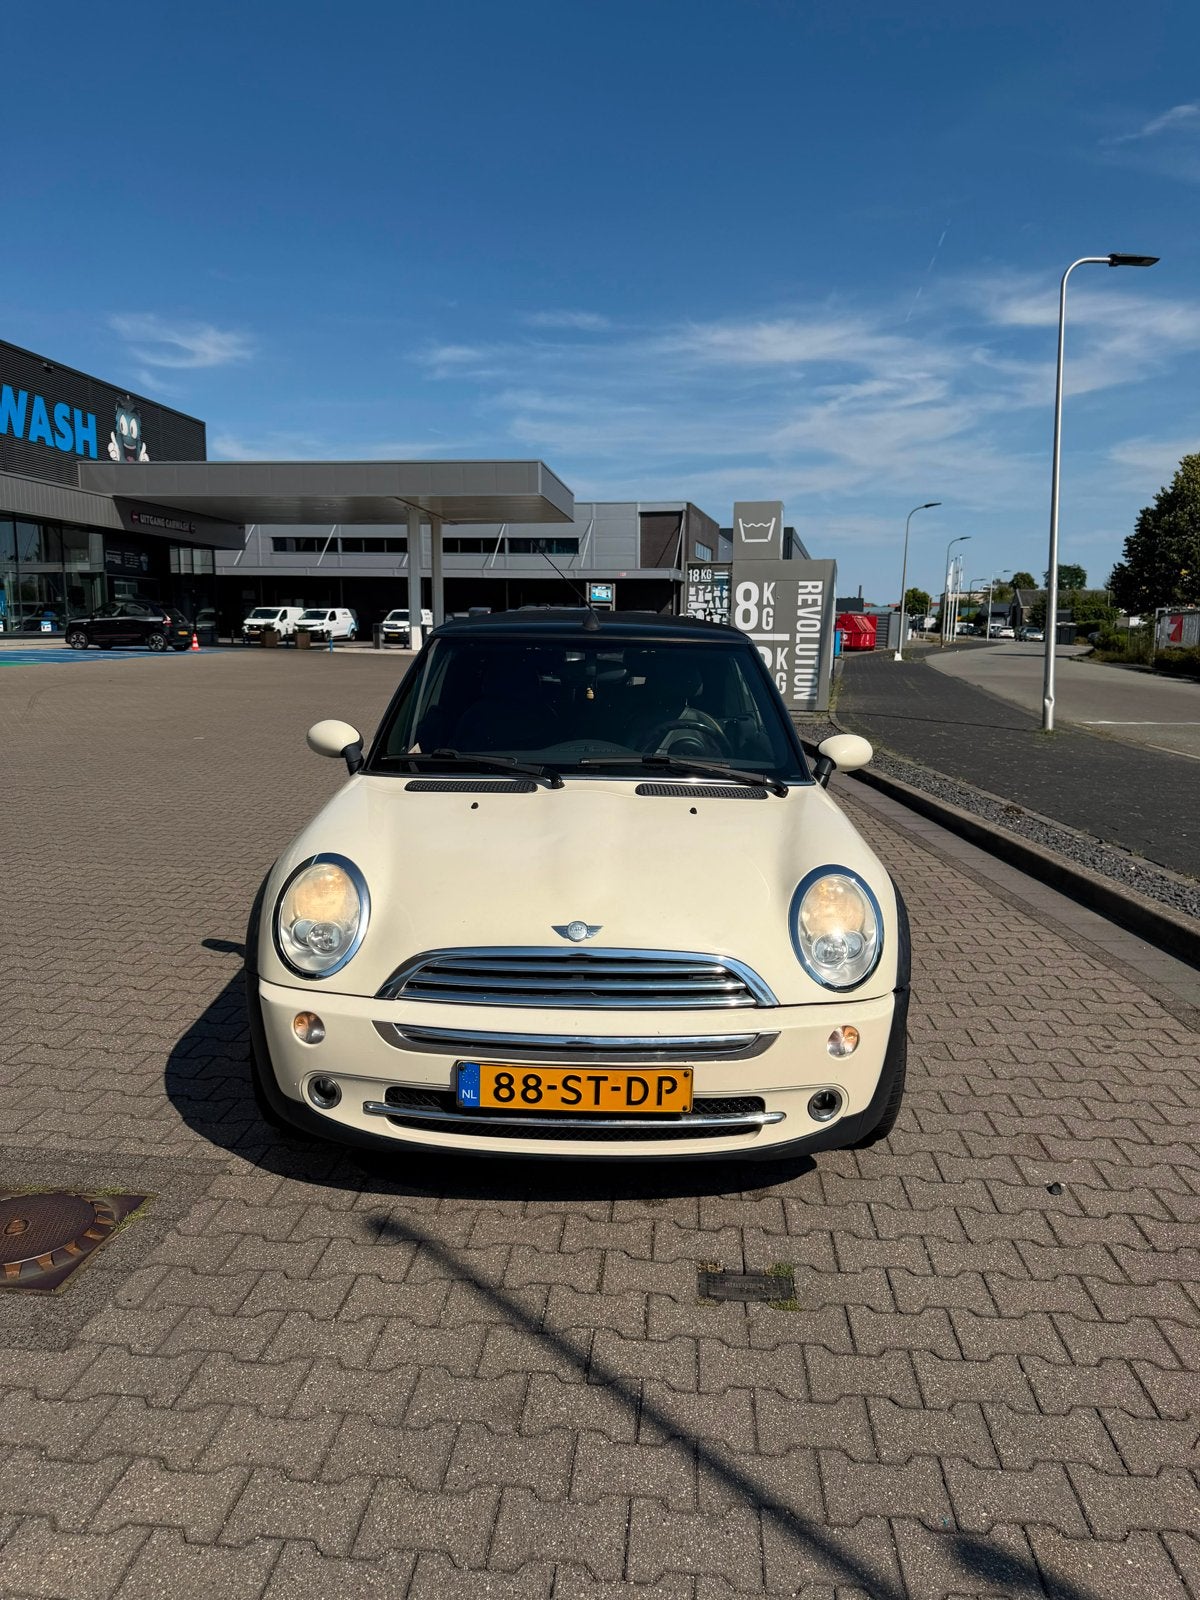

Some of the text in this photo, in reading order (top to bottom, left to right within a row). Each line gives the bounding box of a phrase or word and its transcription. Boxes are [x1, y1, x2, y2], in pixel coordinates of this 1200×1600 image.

[688, 568, 712, 582] 18 KG
[734, 581, 760, 631] 8
[793, 580, 824, 700] REVOLUTION
[461, 1088, 477, 1100] NL
[493, 1071, 679, 1107] 88-ST-DP
